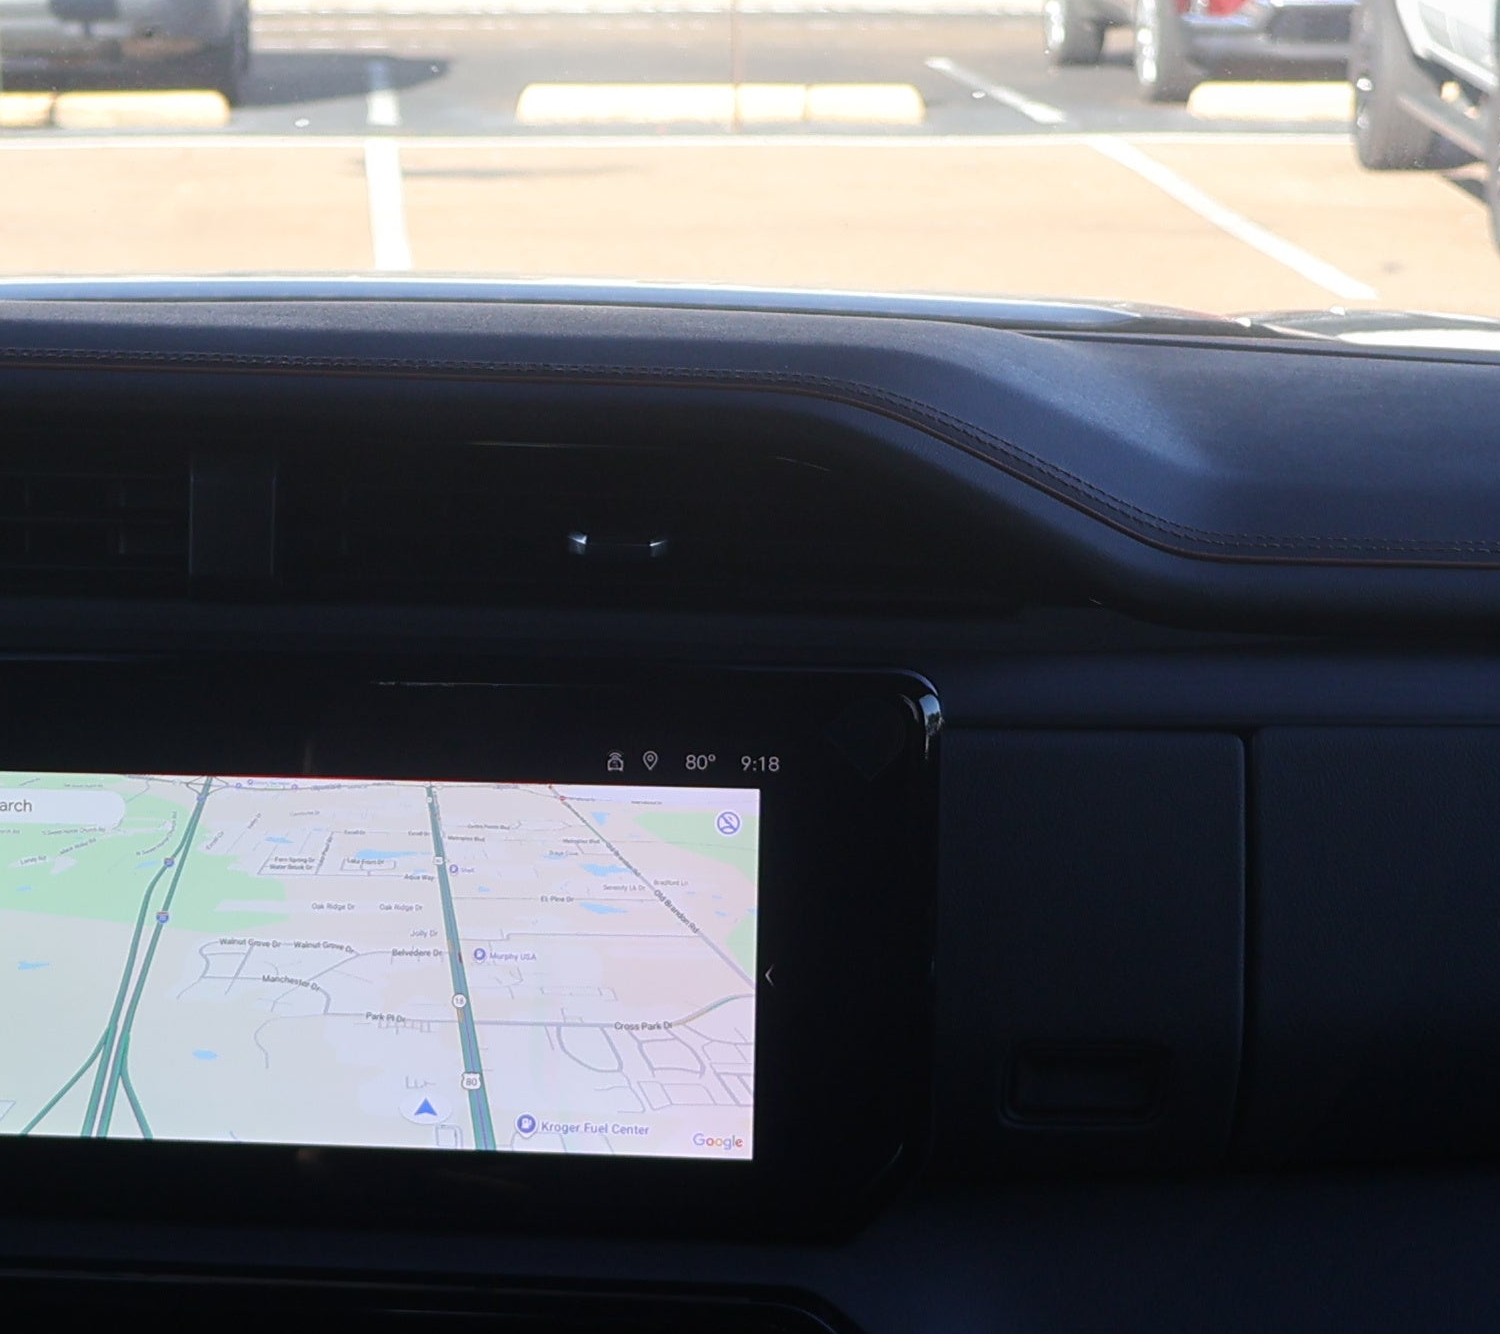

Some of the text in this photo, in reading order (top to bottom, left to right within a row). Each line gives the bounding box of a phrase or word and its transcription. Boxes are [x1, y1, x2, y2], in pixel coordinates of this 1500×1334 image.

[740, 755, 781, 772] 9:18
[421, 874, 435, 883] Way
[311, 902, 325, 910] Oak
[326, 902, 346, 911] Ridge
[378, 903, 393, 911] Oak
[393, 903, 413, 912] Ridge
[664, 899, 690, 926] Brandon
[429, 929, 438, 937] Dr
[218, 938, 282, 948] Walnut Grove Dr
[293, 941, 321, 949] Walnut
[322, 941, 344, 951] Grove
[391, 948, 443, 957] Belvedere Dr
[489, 951, 537, 963] Murphy USA
[262, 974, 321, 992] Manchester Dr
[365, 1011, 407, 1024] Park Pl Dr
[614, 1021, 639, 1031] Cross
[640, 1021, 662, 1031] Park
[465, 1077, 478, 1087] 80
[541, 1121, 650, 1136] Kroger Fuel Center
[692, 1132, 744, 1150] Google
